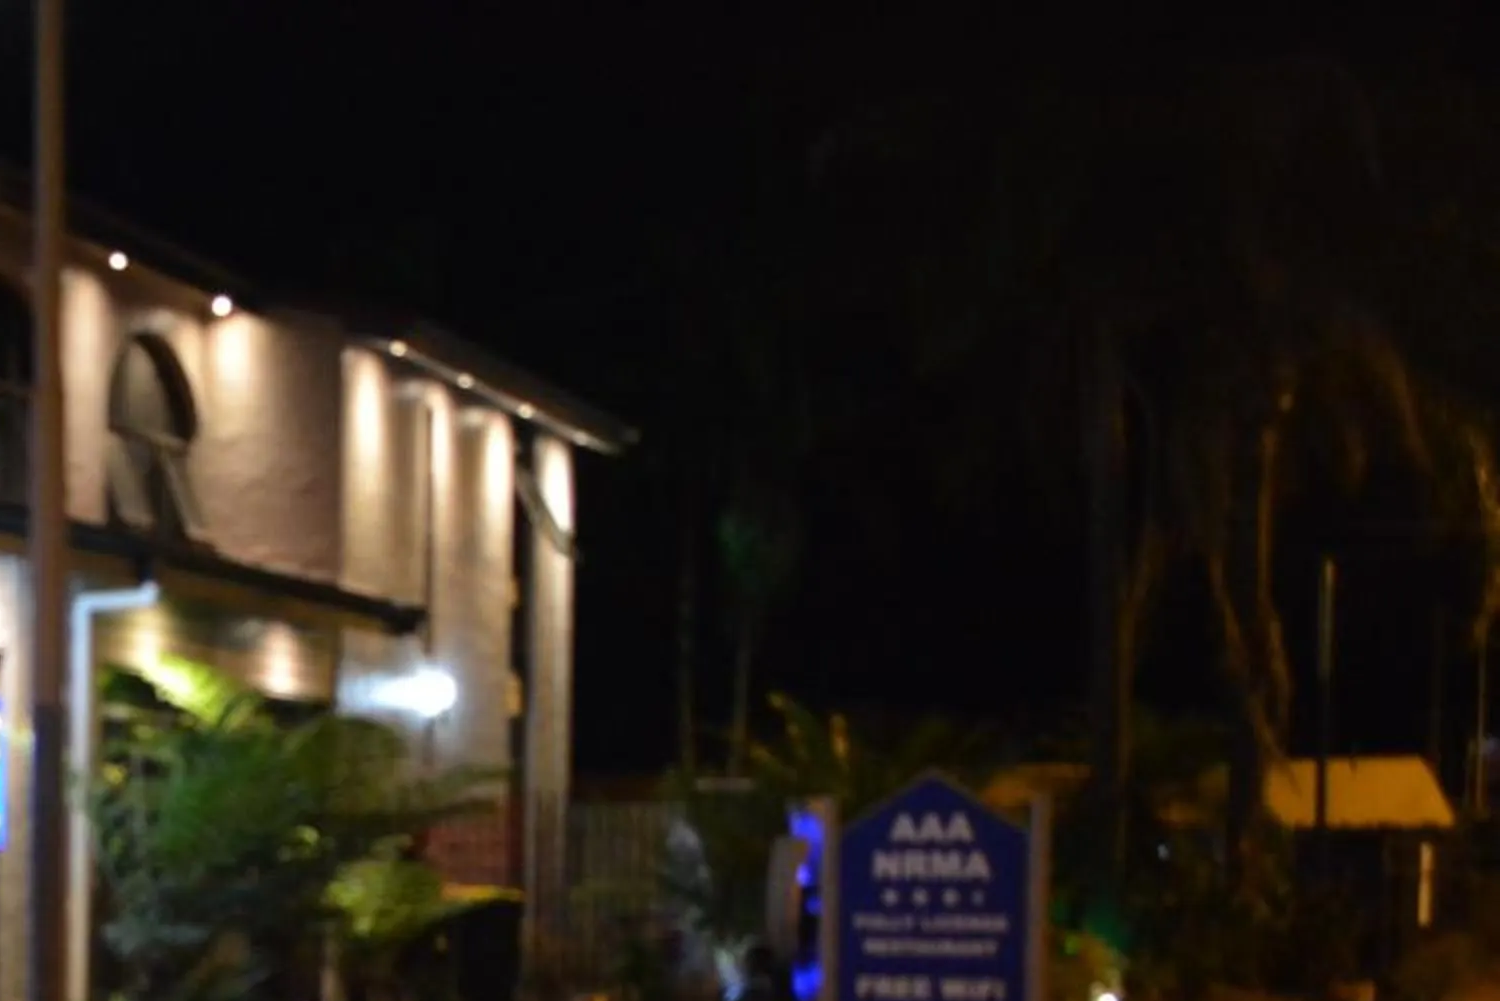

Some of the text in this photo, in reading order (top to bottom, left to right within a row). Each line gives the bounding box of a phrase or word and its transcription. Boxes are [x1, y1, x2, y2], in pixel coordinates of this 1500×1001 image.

[891, 811, 975, 843] AAA
[872, 849, 991, 880] NRMA
[855, 974, 931, 1001] FREE
